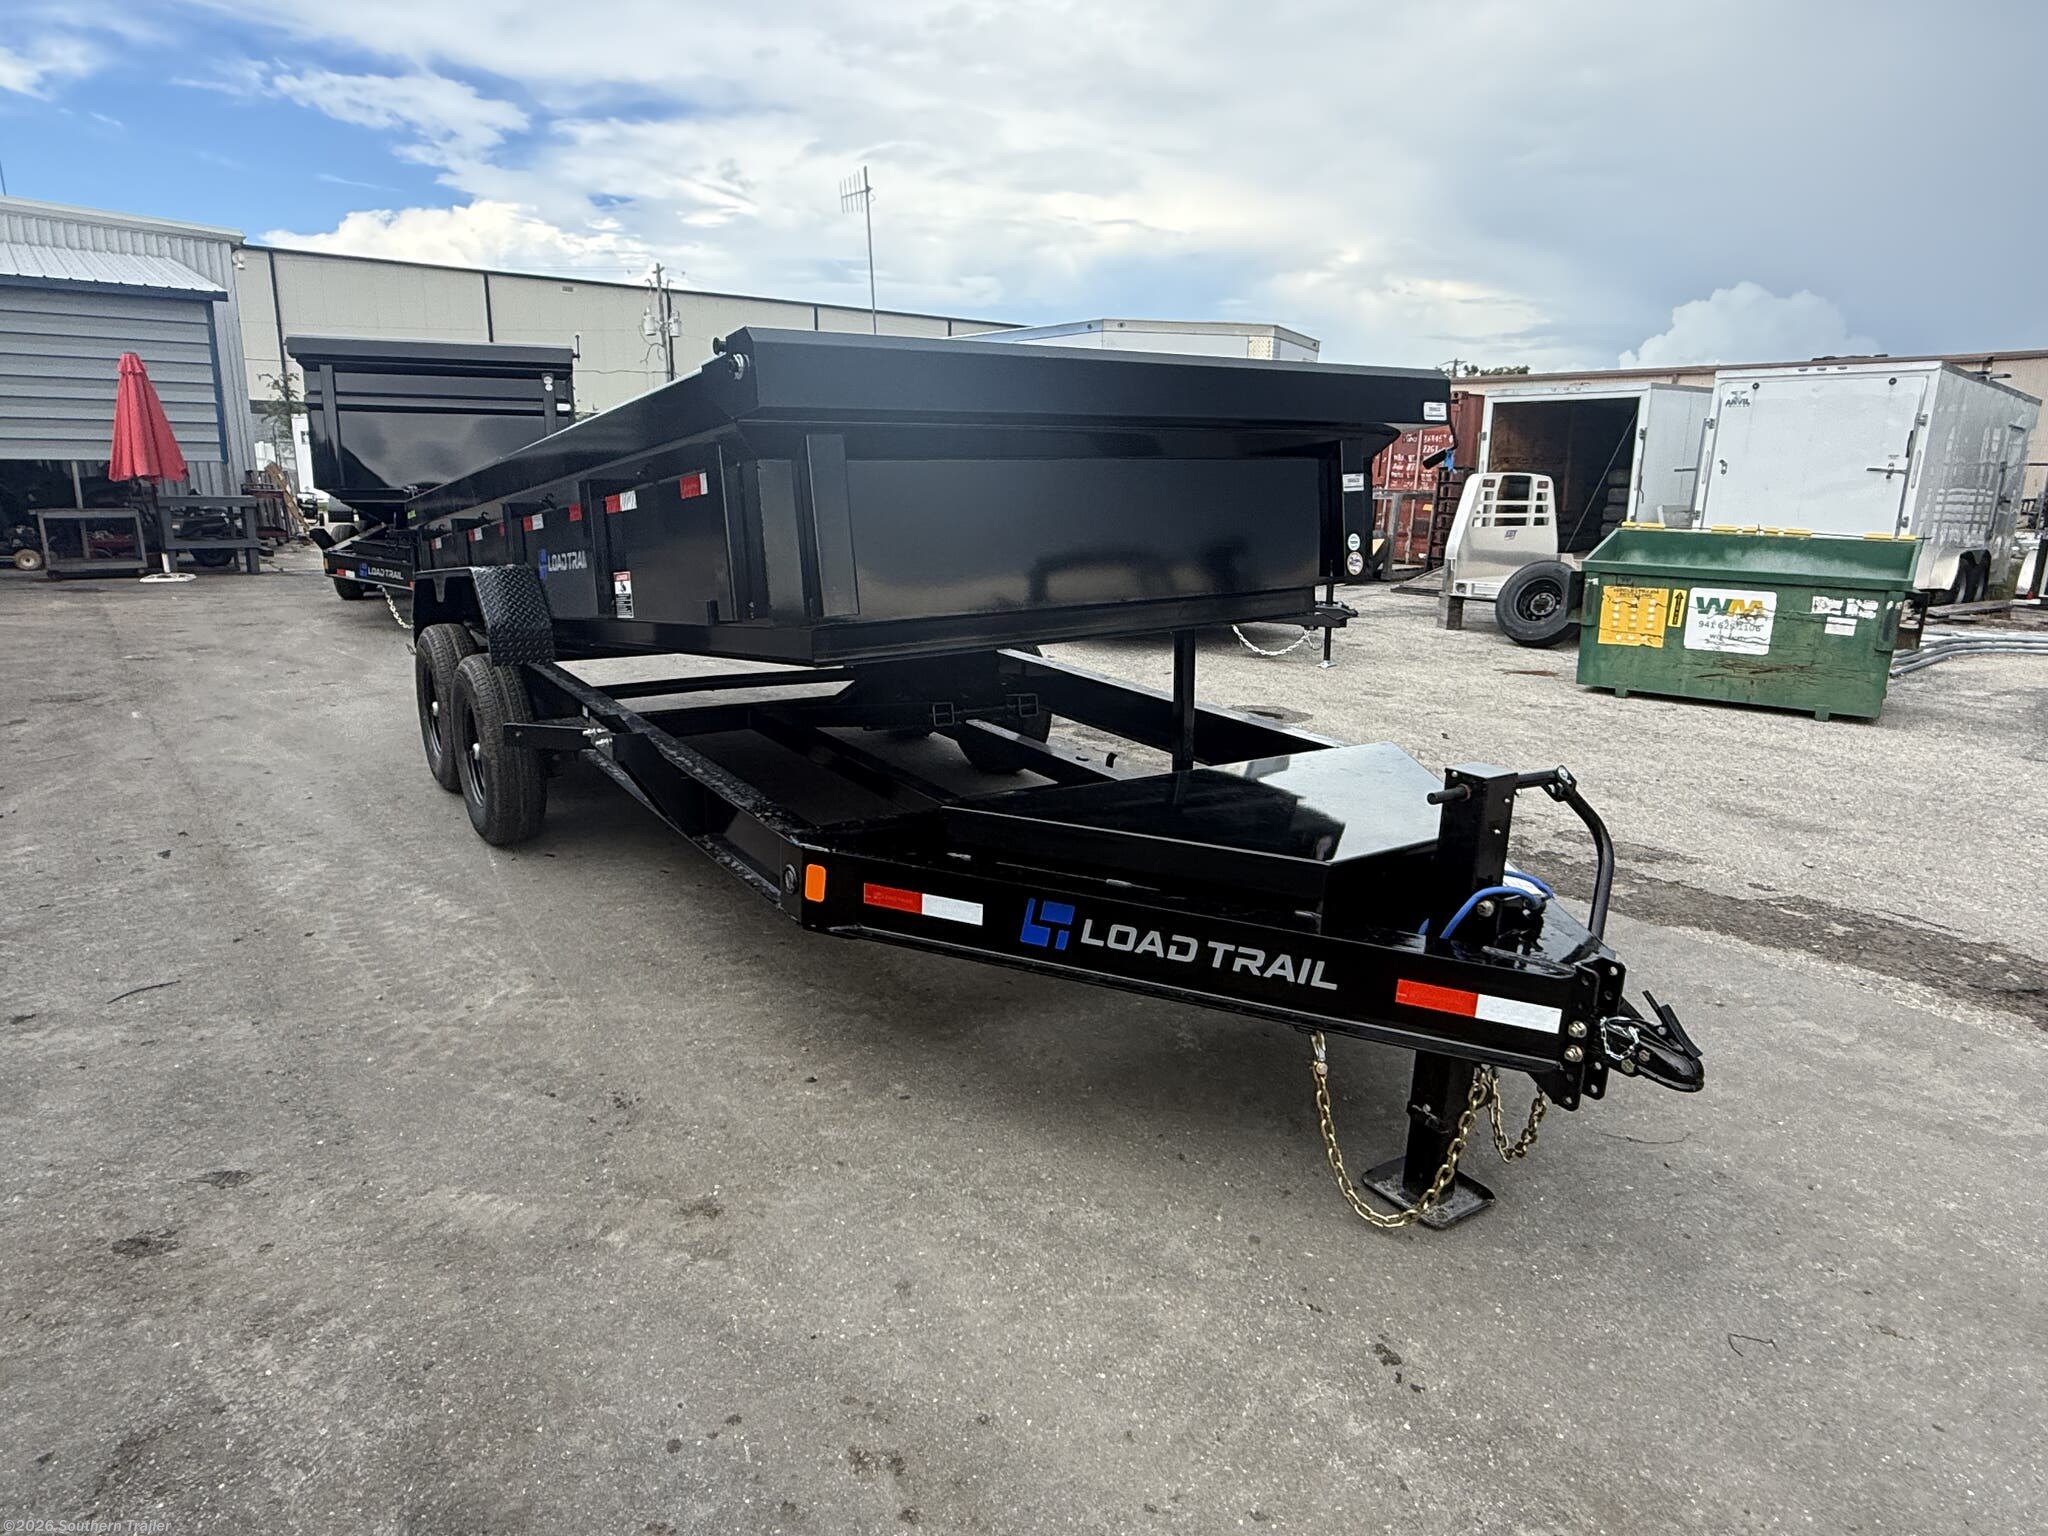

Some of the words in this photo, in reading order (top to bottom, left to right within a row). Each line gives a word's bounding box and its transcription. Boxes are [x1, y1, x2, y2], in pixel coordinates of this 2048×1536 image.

[547, 553, 567, 572] LOAD
[367, 567, 385, 577] LOAD
[385, 569, 404, 580] TRAIL
[1696, 597, 1764, 617] WM
[1698, 620, 1715, 629] 941
[1081, 919, 1199, 963] LOAD
[1207, 941, 1338, 991] TRAIL
